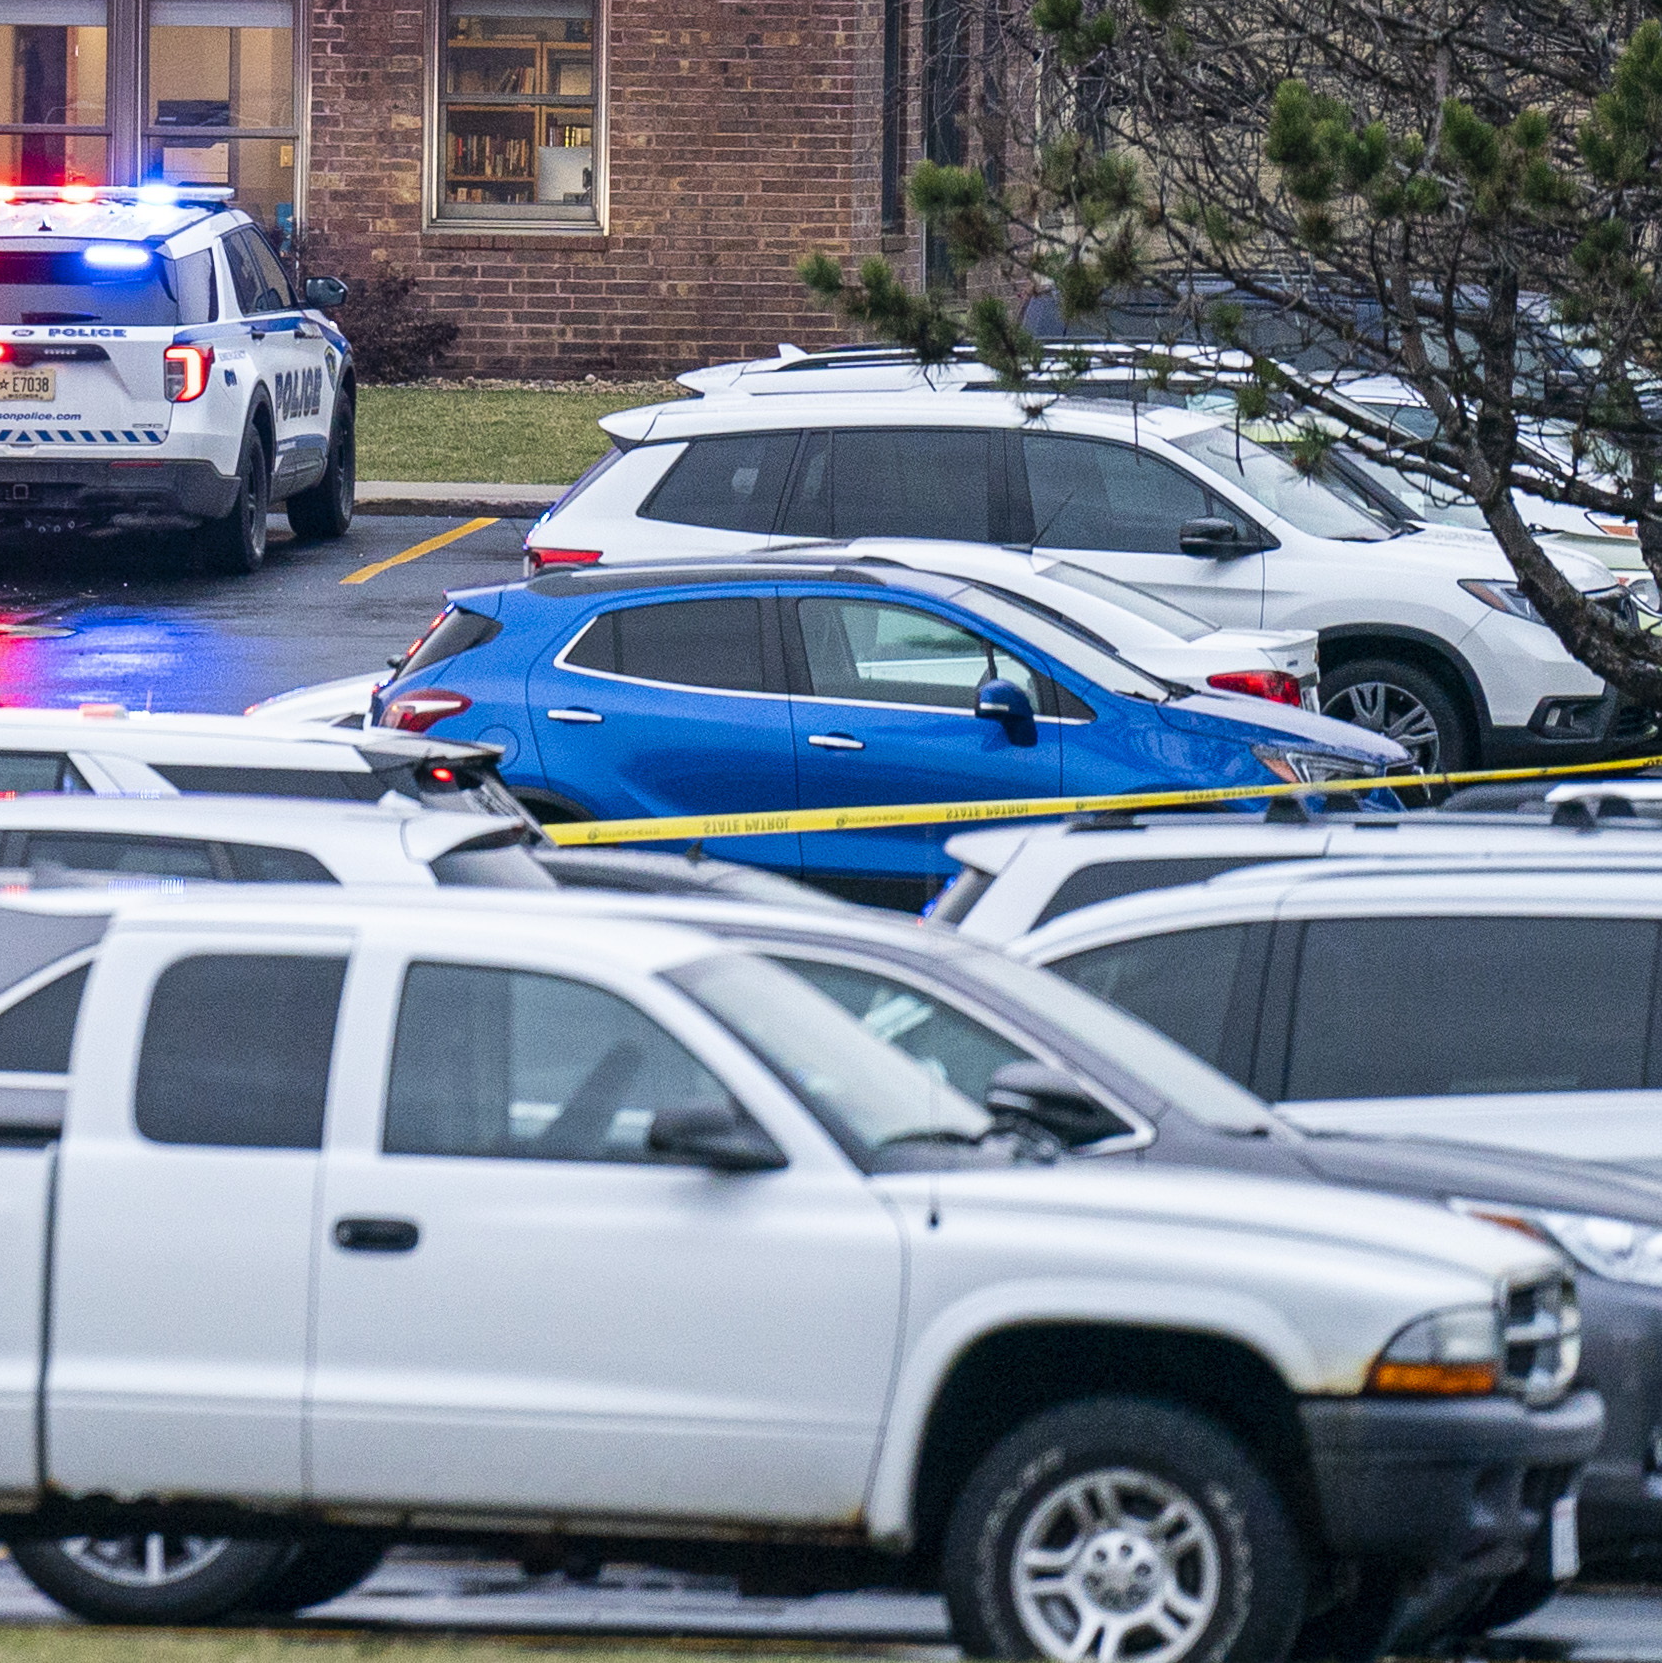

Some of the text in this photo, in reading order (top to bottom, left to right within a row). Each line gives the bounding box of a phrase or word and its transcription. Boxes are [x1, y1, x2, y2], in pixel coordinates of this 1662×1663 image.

[47, 327, 128, 338] POLICE
[12, 376, 50, 393] E7038
[275, 365, 323, 423] POLICE
